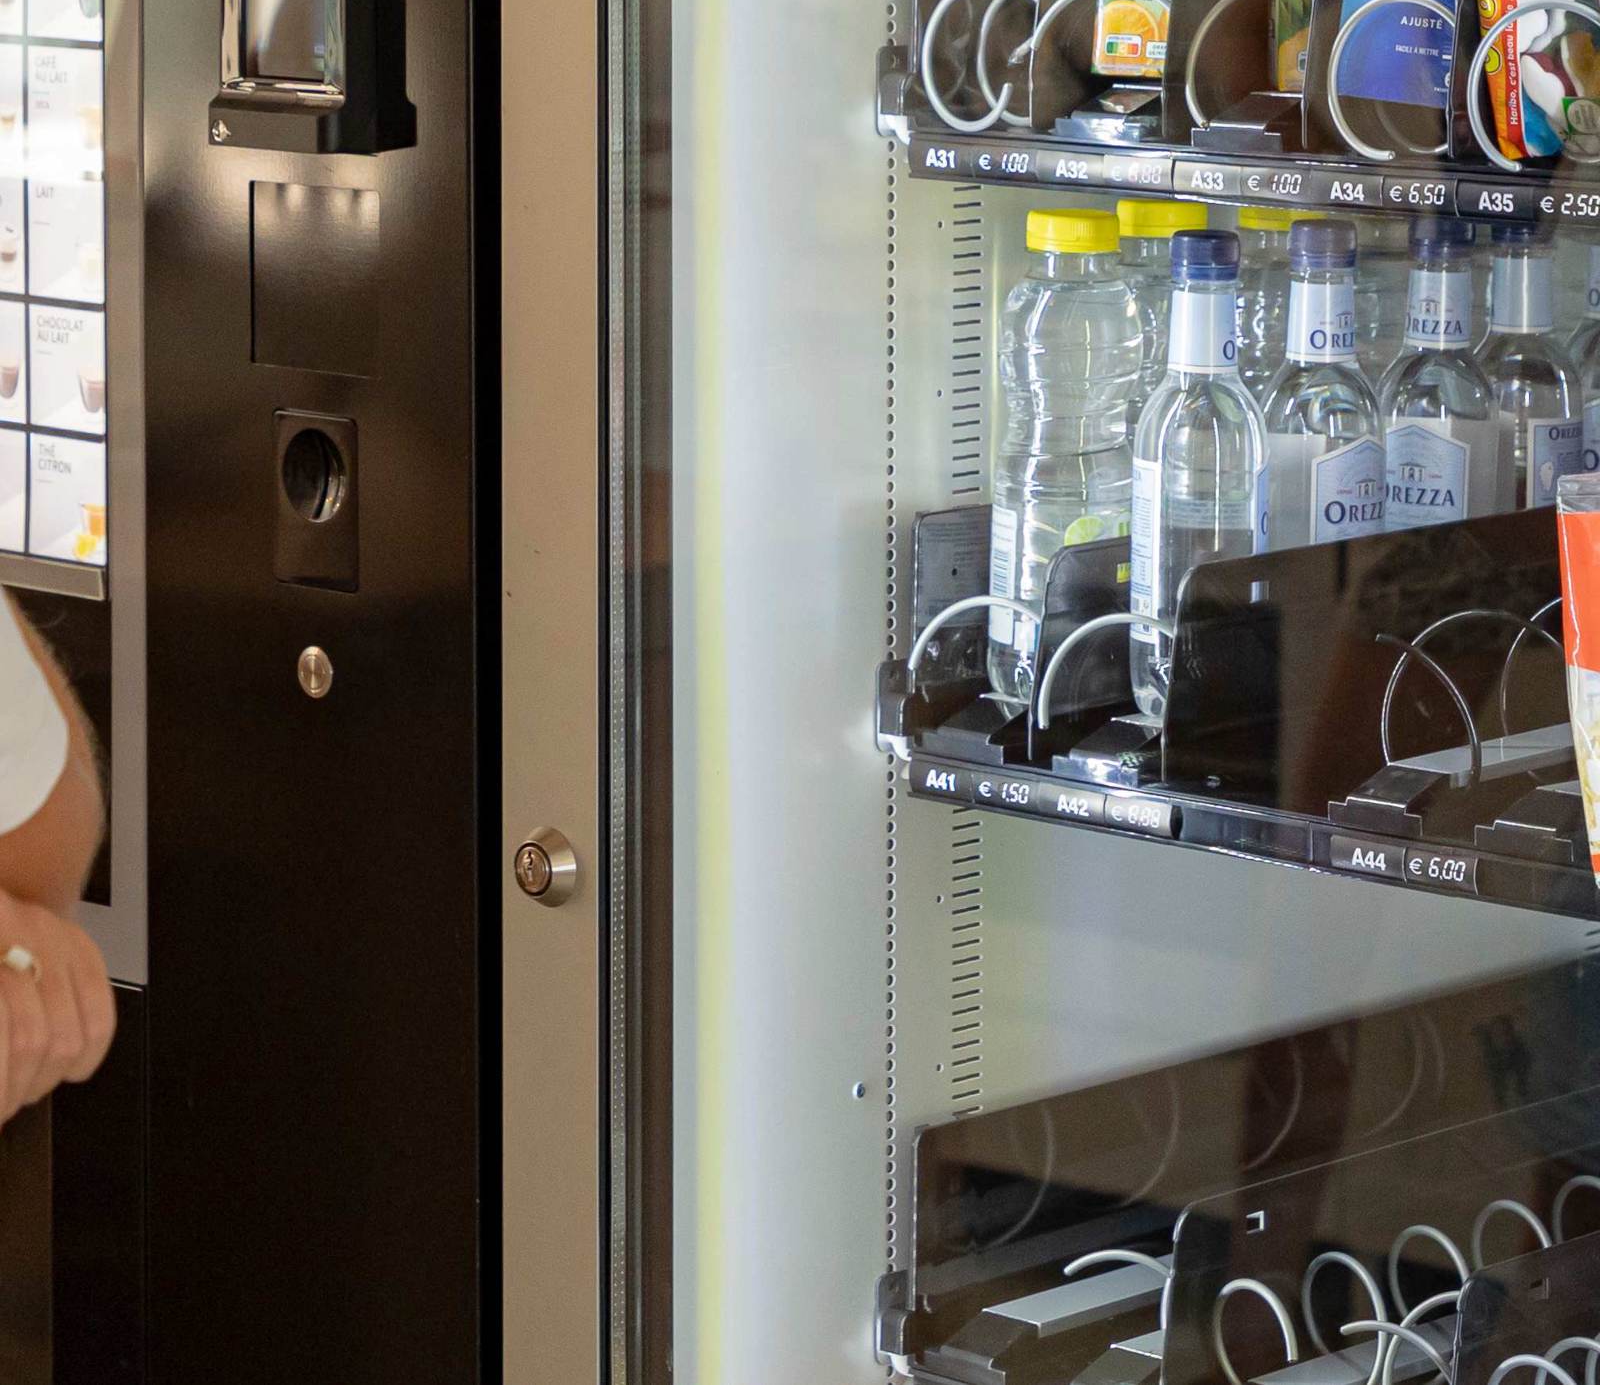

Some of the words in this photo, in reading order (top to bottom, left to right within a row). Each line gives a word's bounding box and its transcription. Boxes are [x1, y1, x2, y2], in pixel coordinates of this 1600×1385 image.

[1400, 16, 1443, 29] AJUSTÉ
[1505, 33, 1516, 61] beau
[925, 148, 955, 169] A31
[978, 153, 992, 170] €
[1001, 152, 1029, 174] 1,00
[1055, 159, 1089, 180] A32
[1111, 164, 1123, 181] €
[35, 186, 55, 199] LAIT
[1190, 170, 1225, 191] A33
[1247, 175, 1261, 191] €
[1271, 173, 1302, 195] 1,00
[1330, 181, 1365, 201] A34
[1389, 185, 1403, 202] €
[1408, 183, 1445, 205] 6,50
[1478, 191, 1514, 212] A35
[1540, 196, 1555, 213] €
[1561, 193, 1600, 216] 2,50
[36, 315, 84, 332] CHOCOLAT
[37, 330, 49, 343] AU
[51, 331, 70, 344] LAIT
[38, 459, 73, 475] CITRON
[925, 769, 956, 792] A41
[978, 781, 992, 797] €
[1001, 783, 1030, 805] 1,50
[1056, 794, 1090, 816] A42
[1111, 806, 1125, 822] €
[1351, 847, 1387, 871] A44
[1409, 858, 1423, 875] €
[1428, 857, 1466, 882] 6,00
